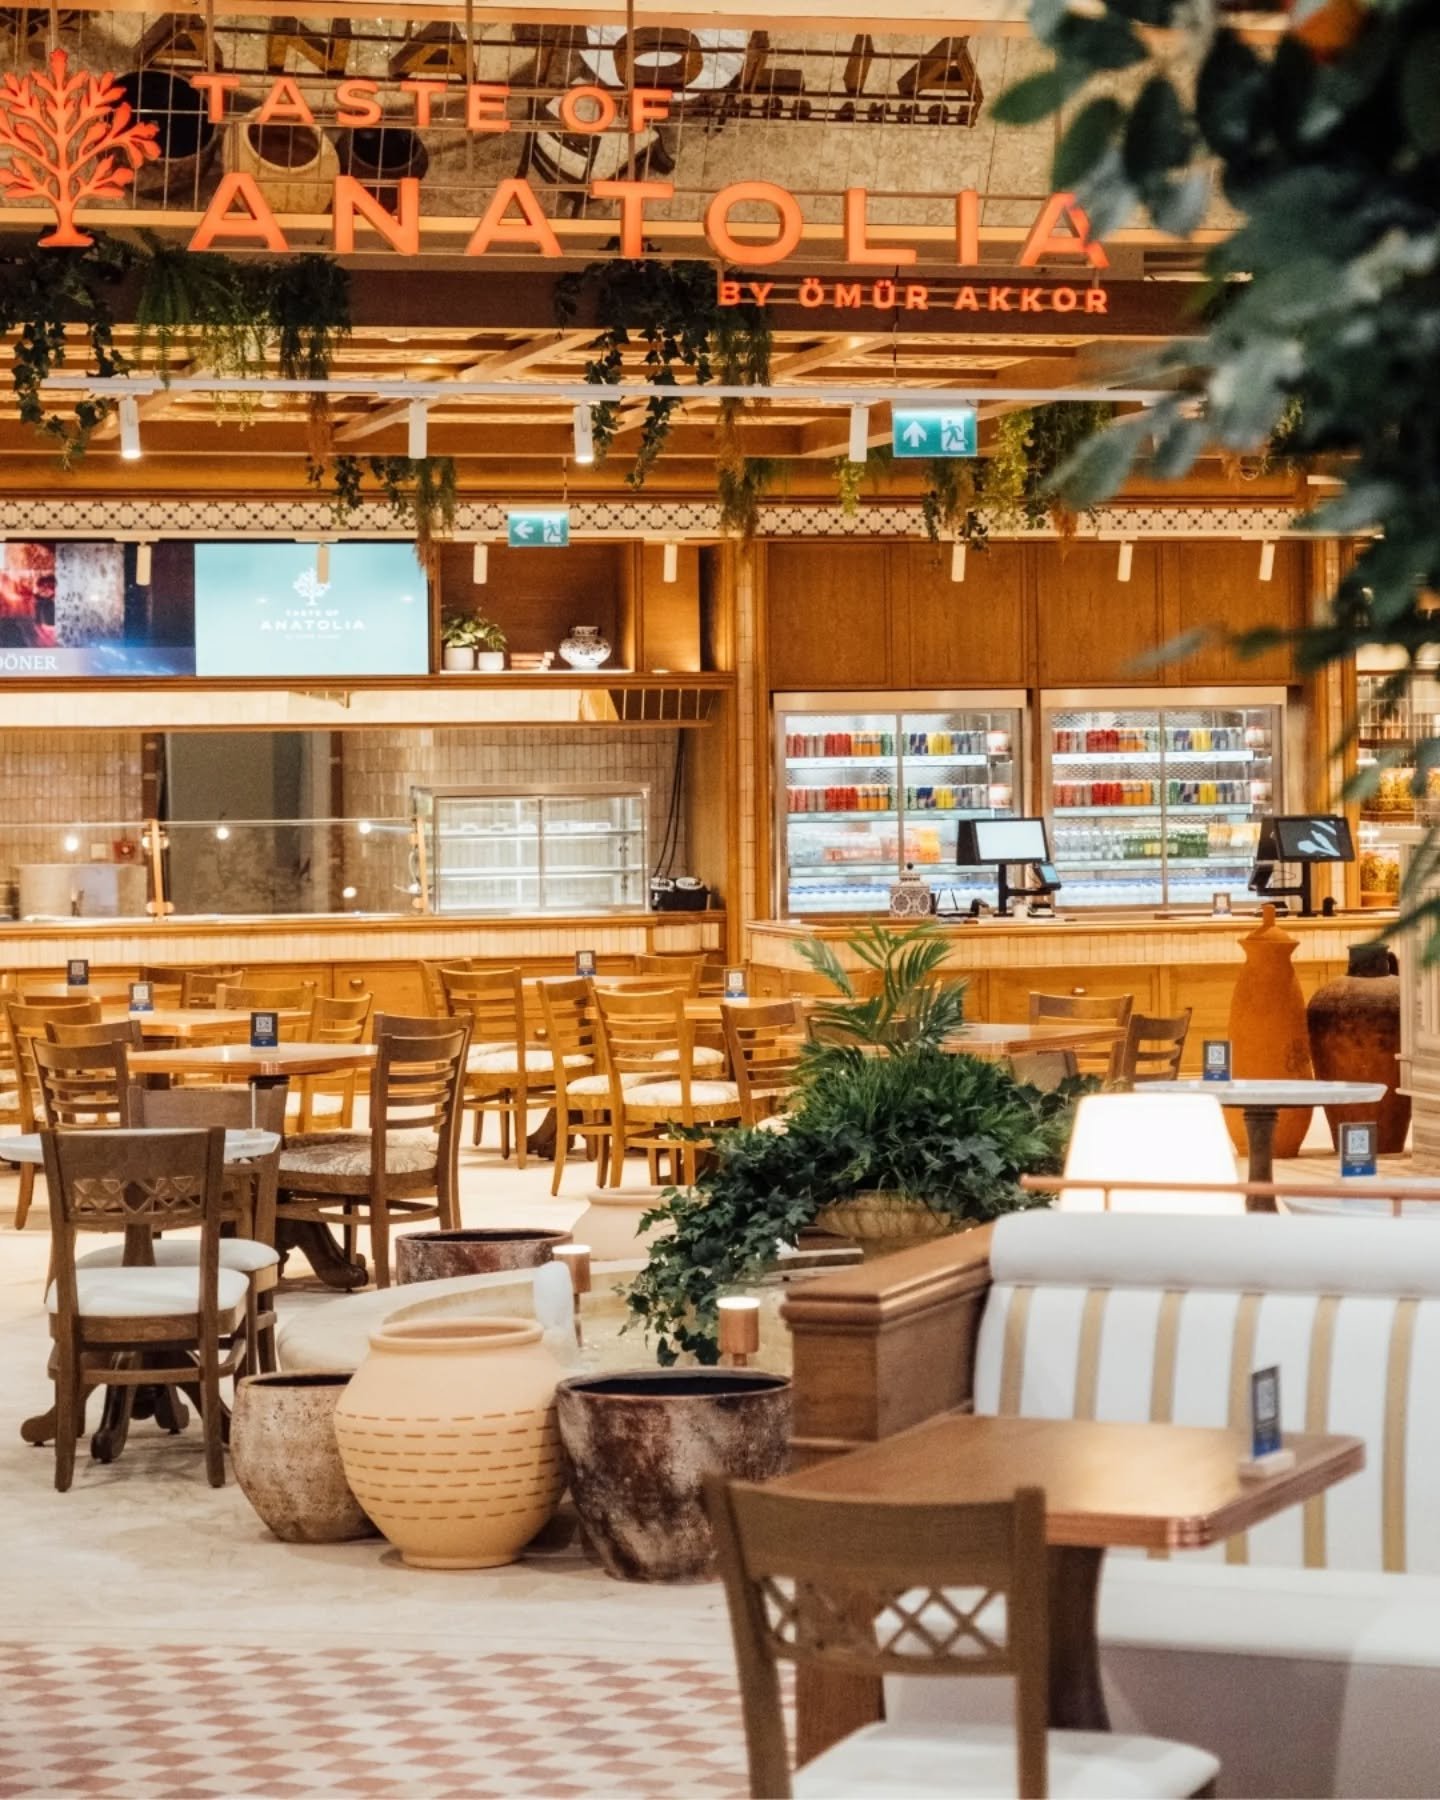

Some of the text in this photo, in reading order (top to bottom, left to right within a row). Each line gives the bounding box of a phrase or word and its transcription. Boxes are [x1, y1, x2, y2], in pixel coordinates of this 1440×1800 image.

[192, 75, 512, 132] TASTE
[560, 86, 673, 134] OF
[188, 171, 1110, 269] ANATOLIA
[718, 278, 1108, 313] BY ÖMÜR AKKOR
[260, 620, 366, 631] ANATOLIA
[0, 653, 58, 670] ÖNER
